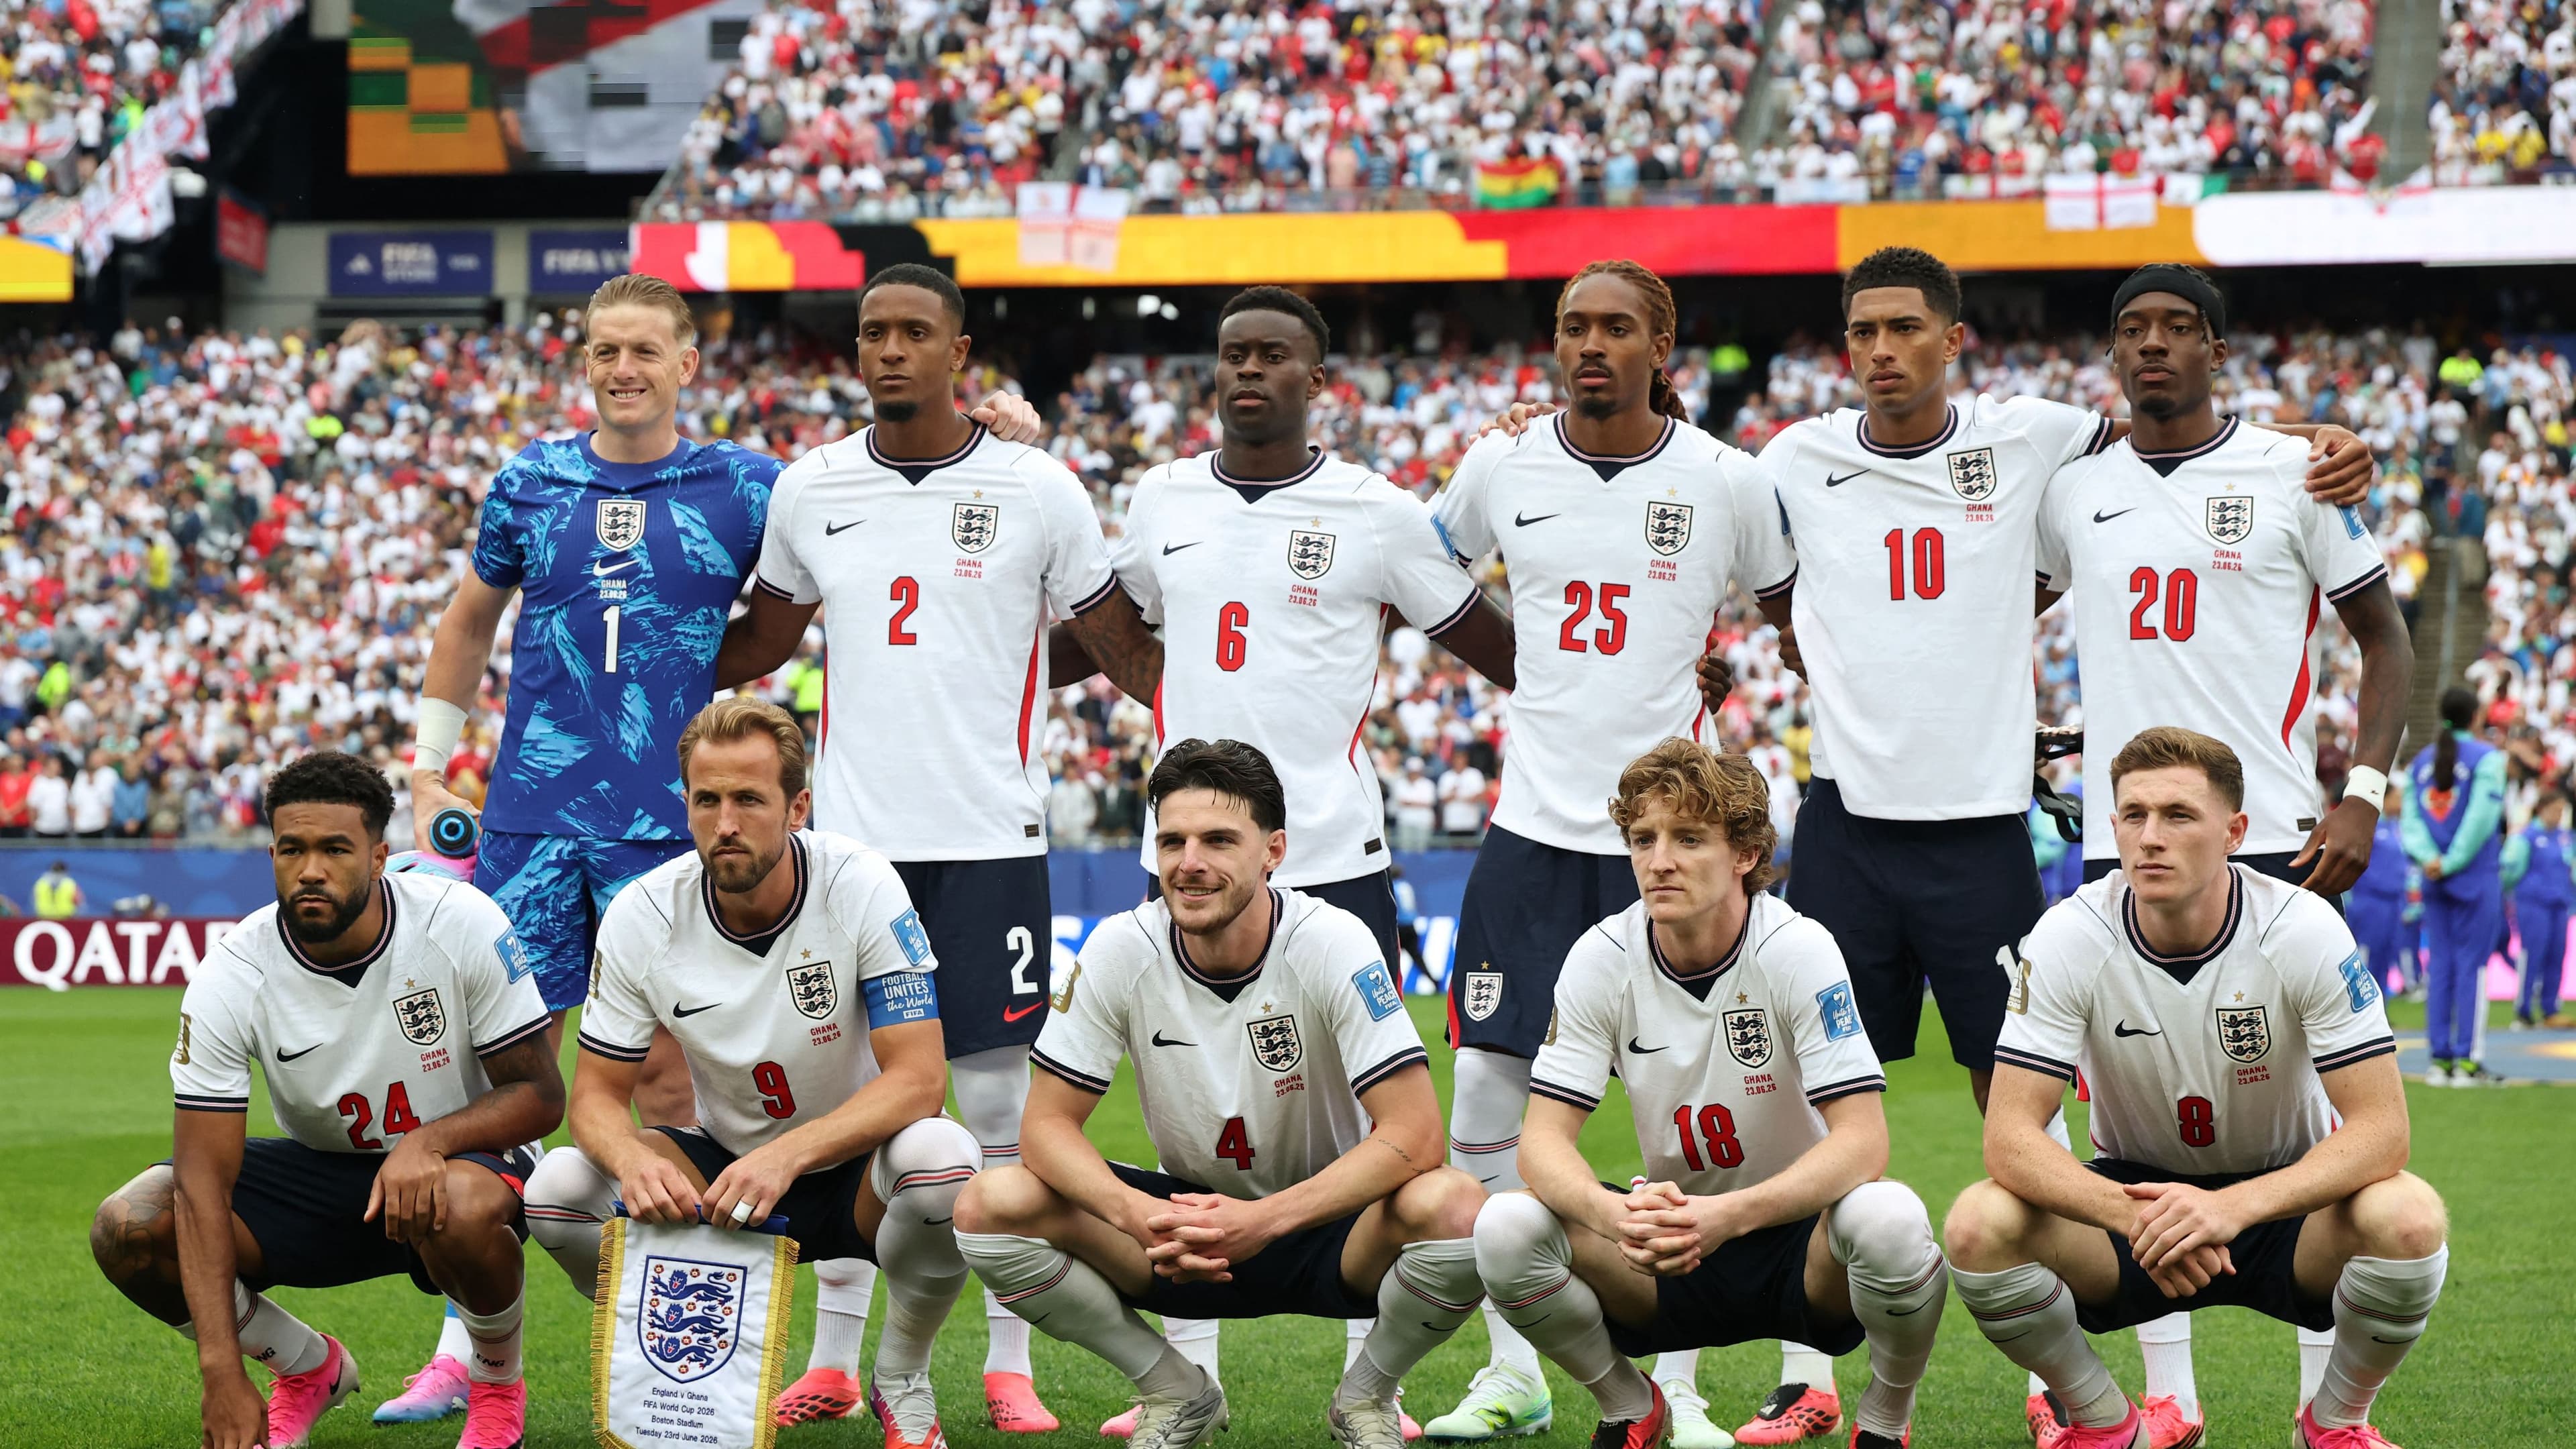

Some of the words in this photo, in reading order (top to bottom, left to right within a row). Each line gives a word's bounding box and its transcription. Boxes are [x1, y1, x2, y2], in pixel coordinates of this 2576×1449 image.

[1966, 504, 1992, 512] GHANA
[2214, 549, 2241, 560] GHANA
[957, 558, 982, 569] GHANA
[1650, 559, 1676, 570] GHANA
[1884, 527, 1945, 600] 10
[954, 568, 982, 579] 23.06.26
[1648, 570, 1676, 582] 23.06.26
[601, 579, 627, 589] GHANA
[1291, 584, 1318, 596] GHANA
[1289, 595, 1317, 606] 23.06.26
[2130, 566, 2198, 642] 20
[889, 576, 919, 645] 2
[1559, 580, 1630, 656] 25
[602, 604, 621, 674] 1
[1216, 601, 1249, 672] 6
[1006, 926, 1038, 995] 2
[882, 973, 926, 987] FOOTBALL
[884, 981, 929, 1000] UNITES
[885, 1000, 905, 1012] the
[905, 994, 933, 1008] World
[810, 1023, 838, 1036] GHANA
[812, 1030, 841, 1046] 23.06.26
[421, 1047, 447, 1062] GHANA
[422, 1056, 450, 1072] 23.06.26
[2237, 1065, 2267, 1076] GHANA
[1274, 1074, 1303, 1089] GHANA
[1743, 1074, 1773, 1084] GHANA
[2238, 1073, 2270, 1085] 23.06.26
[751, 1061, 797, 1120] 9
[1276, 1081, 1305, 1097] 23.06.26
[1745, 1082, 1776, 1095] 23.06.26
[337, 1081, 421, 1149] 24
[2177, 1095, 2215, 1147] 8
[1216, 1116, 1256, 1171] 4
[1674, 1103, 1744, 1171] 18
[477, 1352, 504, 1367] ENG
[652, 1387, 678, 1398] England
[687, 1392, 708, 1401] Ghana
[643, 1400, 657, 1409] FIFA
[660, 1403, 679, 1412] World
[681, 1404, 694, 1415] Cup
[697, 1407, 714, 1416] 2026
[651, 1415, 674, 1426] Boston
[676, 1417, 704, 1429] Stadium
[635, 1426, 661, 1439] Tuesday
[664, 1431, 680, 1440] 23rd
[682, 1433, 698, 1442] June
[700, 1435, 718, 1444] 2026
